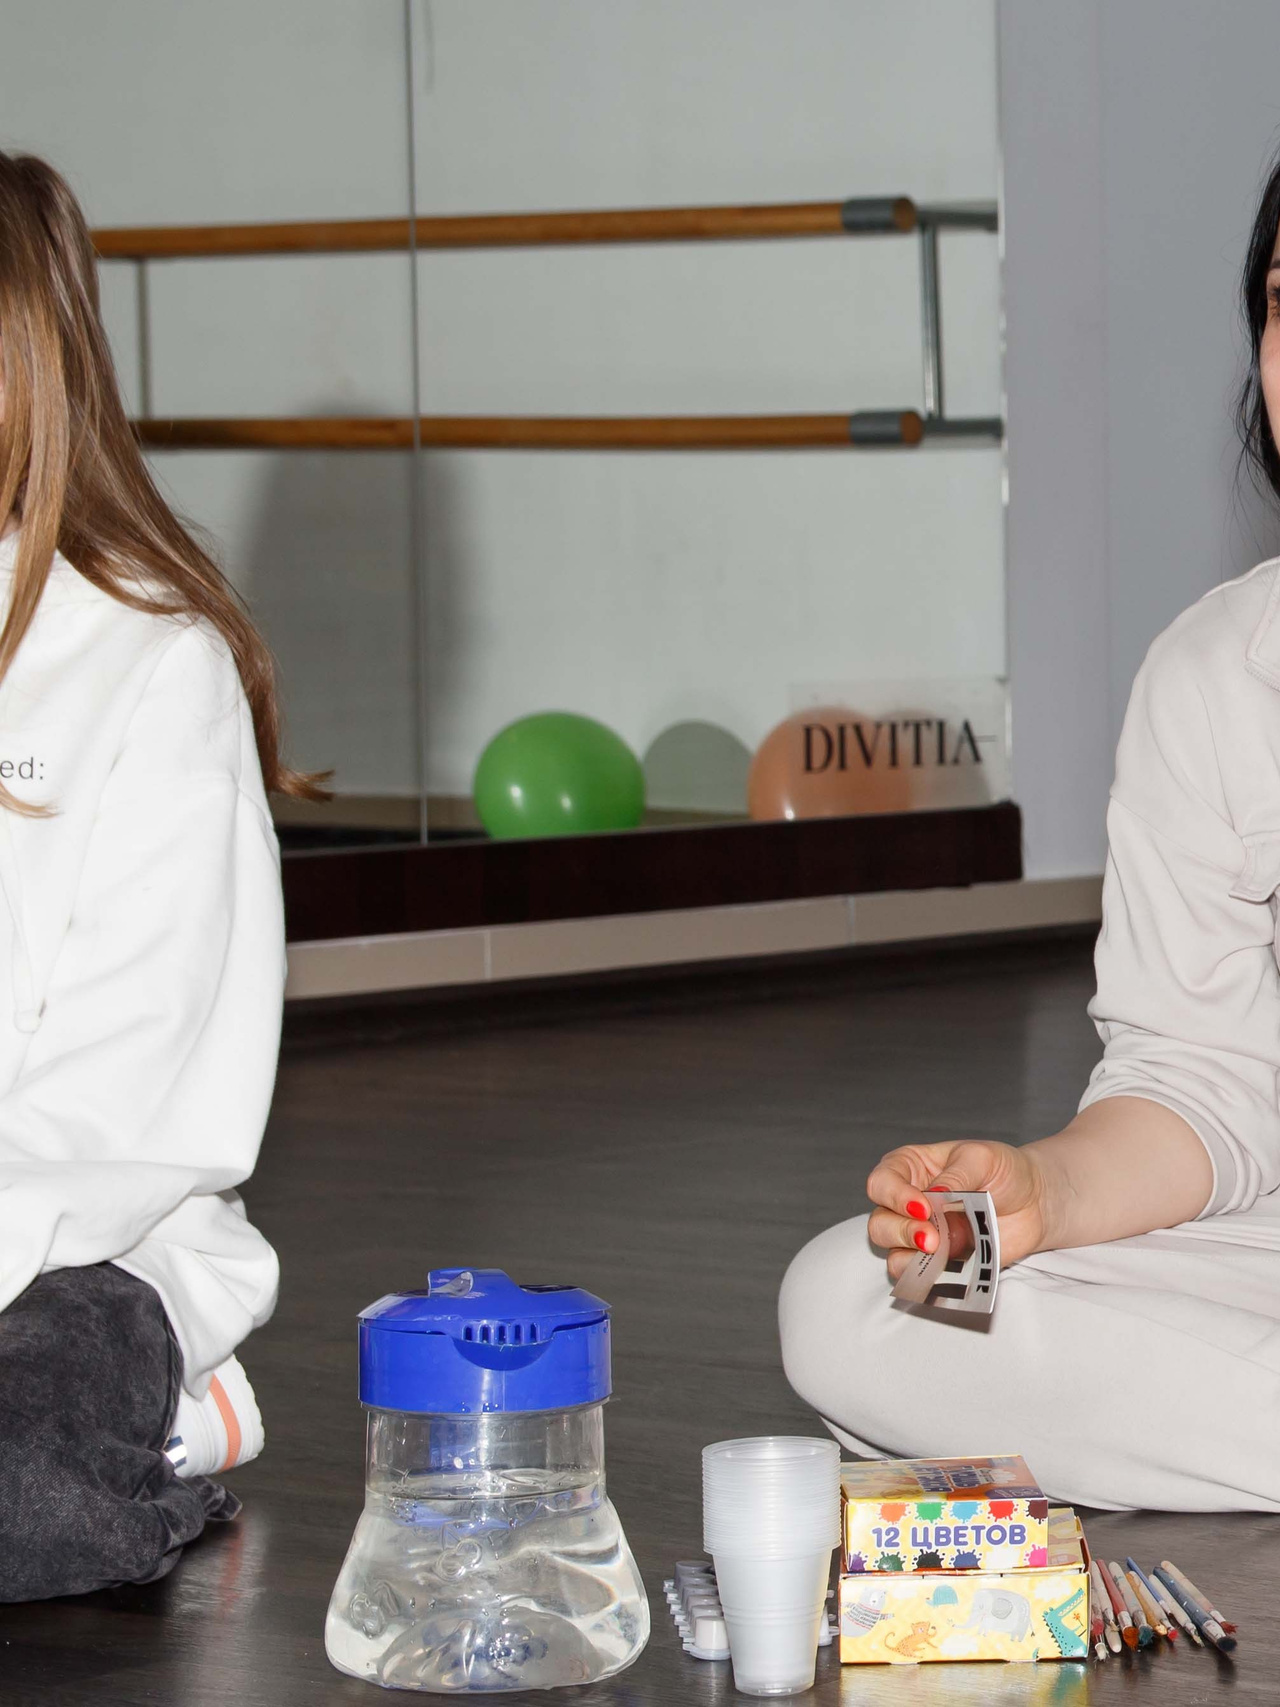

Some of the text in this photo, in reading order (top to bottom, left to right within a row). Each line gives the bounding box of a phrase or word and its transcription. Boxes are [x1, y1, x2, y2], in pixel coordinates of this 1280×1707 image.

[803, 719, 981, 774] DIVITIA
[0, 757, 44, 780] ed:
[872, 1524, 1026, 1550] 12 ЦВЕТОВ
